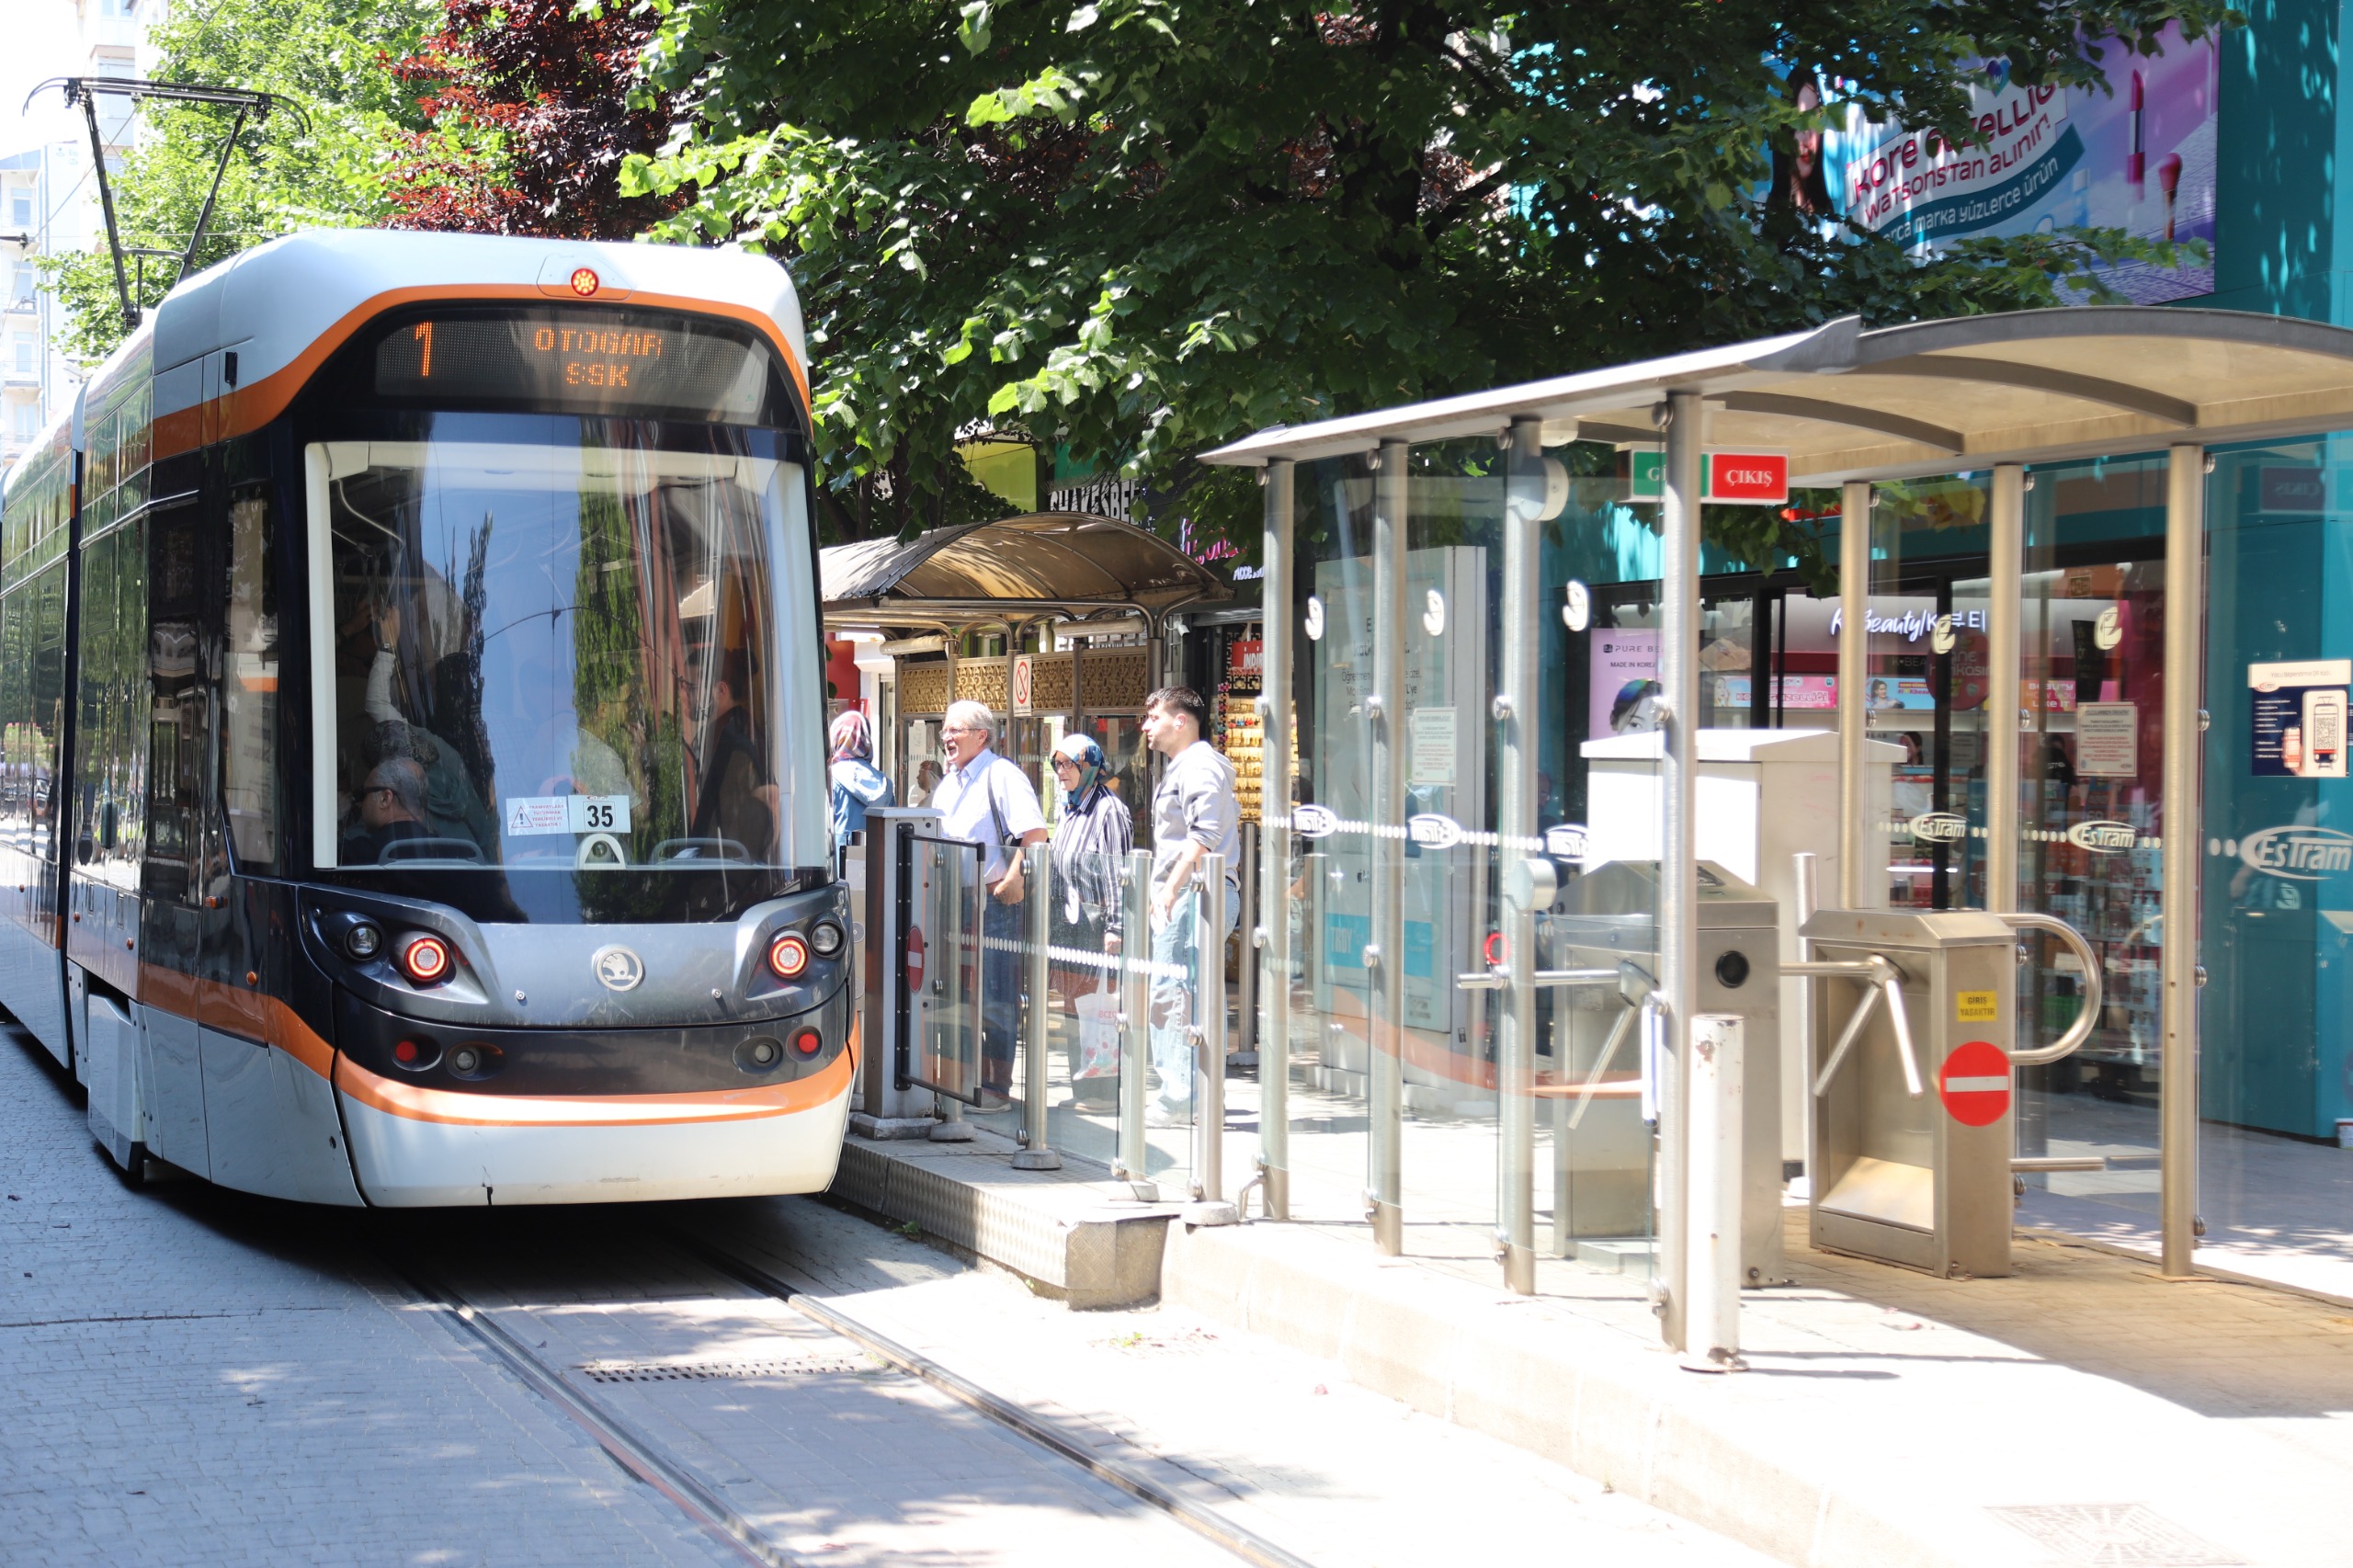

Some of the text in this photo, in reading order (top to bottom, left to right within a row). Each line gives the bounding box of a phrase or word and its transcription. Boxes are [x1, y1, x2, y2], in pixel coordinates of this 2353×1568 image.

[1915, 206, 1956, 232] marka
[2024, 156, 2059, 196] ürün
[415, 322, 432, 377] 1
[535, 328, 662, 357] OTOGAR
[566, 362, 629, 387] SSK
[1725, 469, 1774, 487] ÇIKIŞ
[586, 805, 614, 827] 35
[1919, 818, 1967, 837] EsTram
[2080, 826, 2135, 848] EsTram
[2258, 835, 2353, 871] EsTram
[1967, 995, 1987, 1006] GİRİŞ
[1960, 1007, 1995, 1017] YASAKTIR
